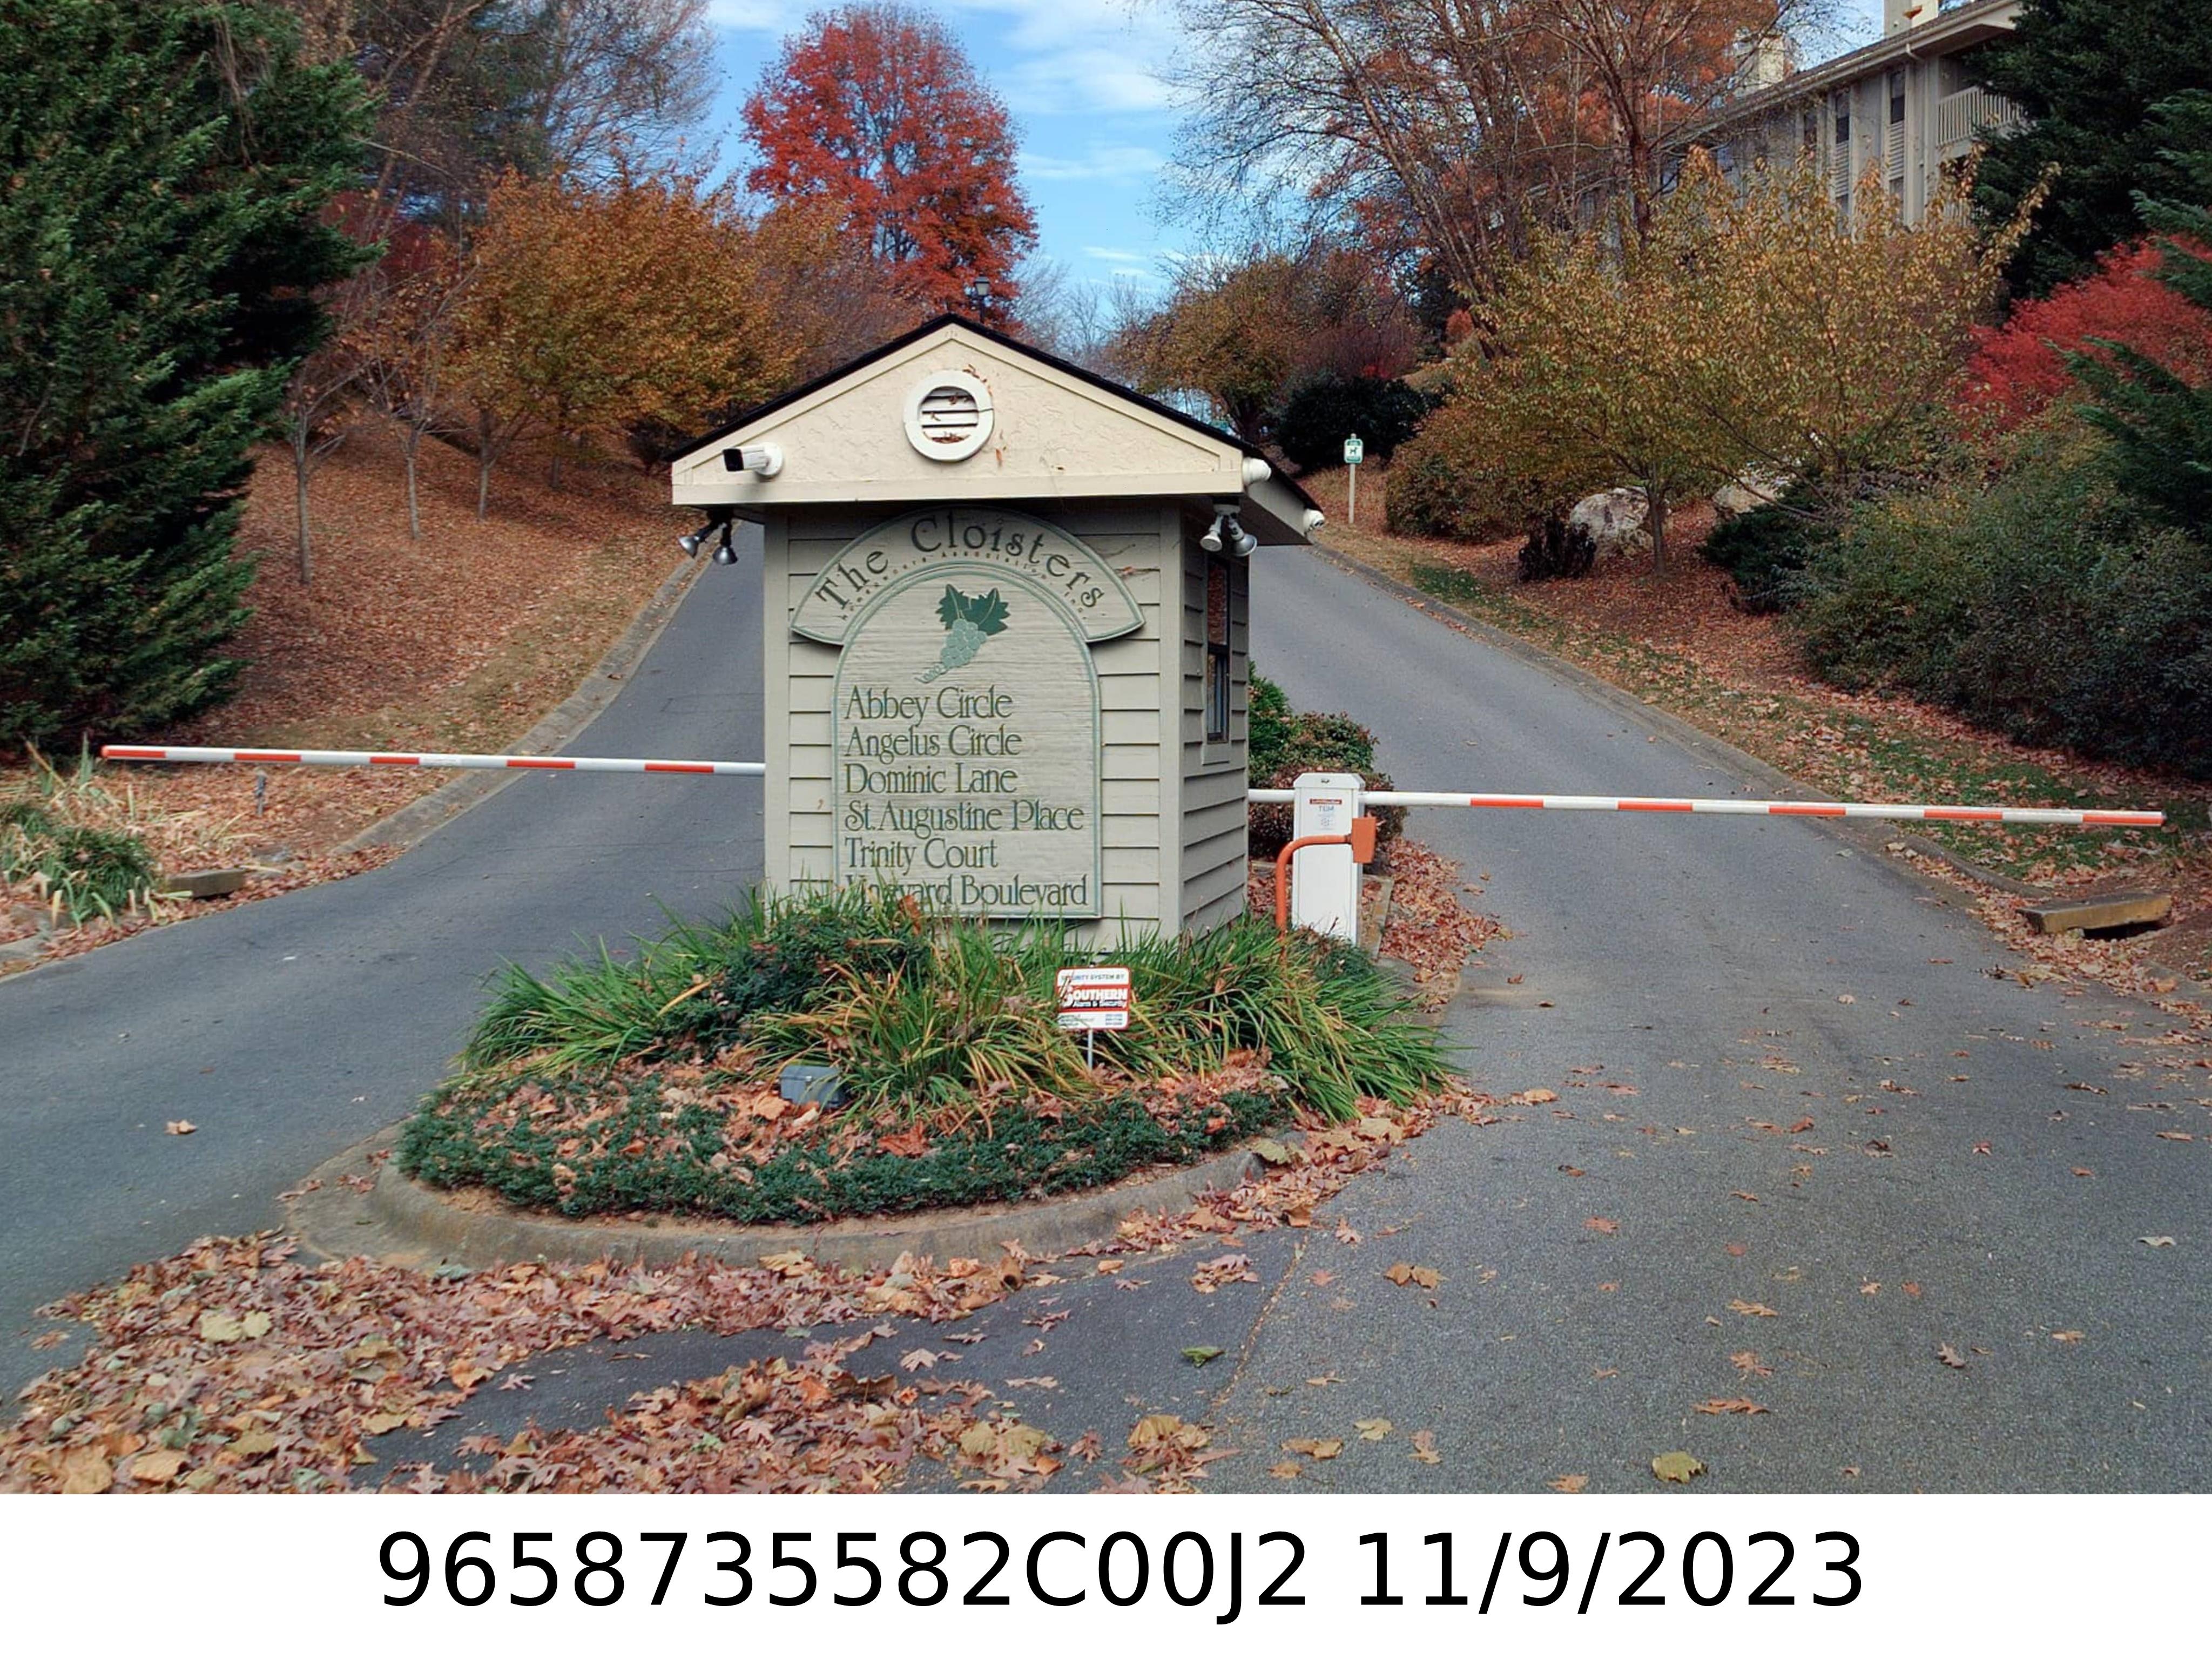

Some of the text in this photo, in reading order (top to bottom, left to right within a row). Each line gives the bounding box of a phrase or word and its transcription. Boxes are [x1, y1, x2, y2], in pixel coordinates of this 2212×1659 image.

[816, 512, 1104, 610] The Cloisters
[844, 685, 1013, 727] Abbey Circle
[844, 724, 1022, 765] Angelus Circle
[844, 762, 1018, 794] Dominic Lane
[845, 799, 1084, 840] St. Augustine Place
[844, 837, 999, 875] Trinity Court
[961, 874, 1088, 906] Boulevard
